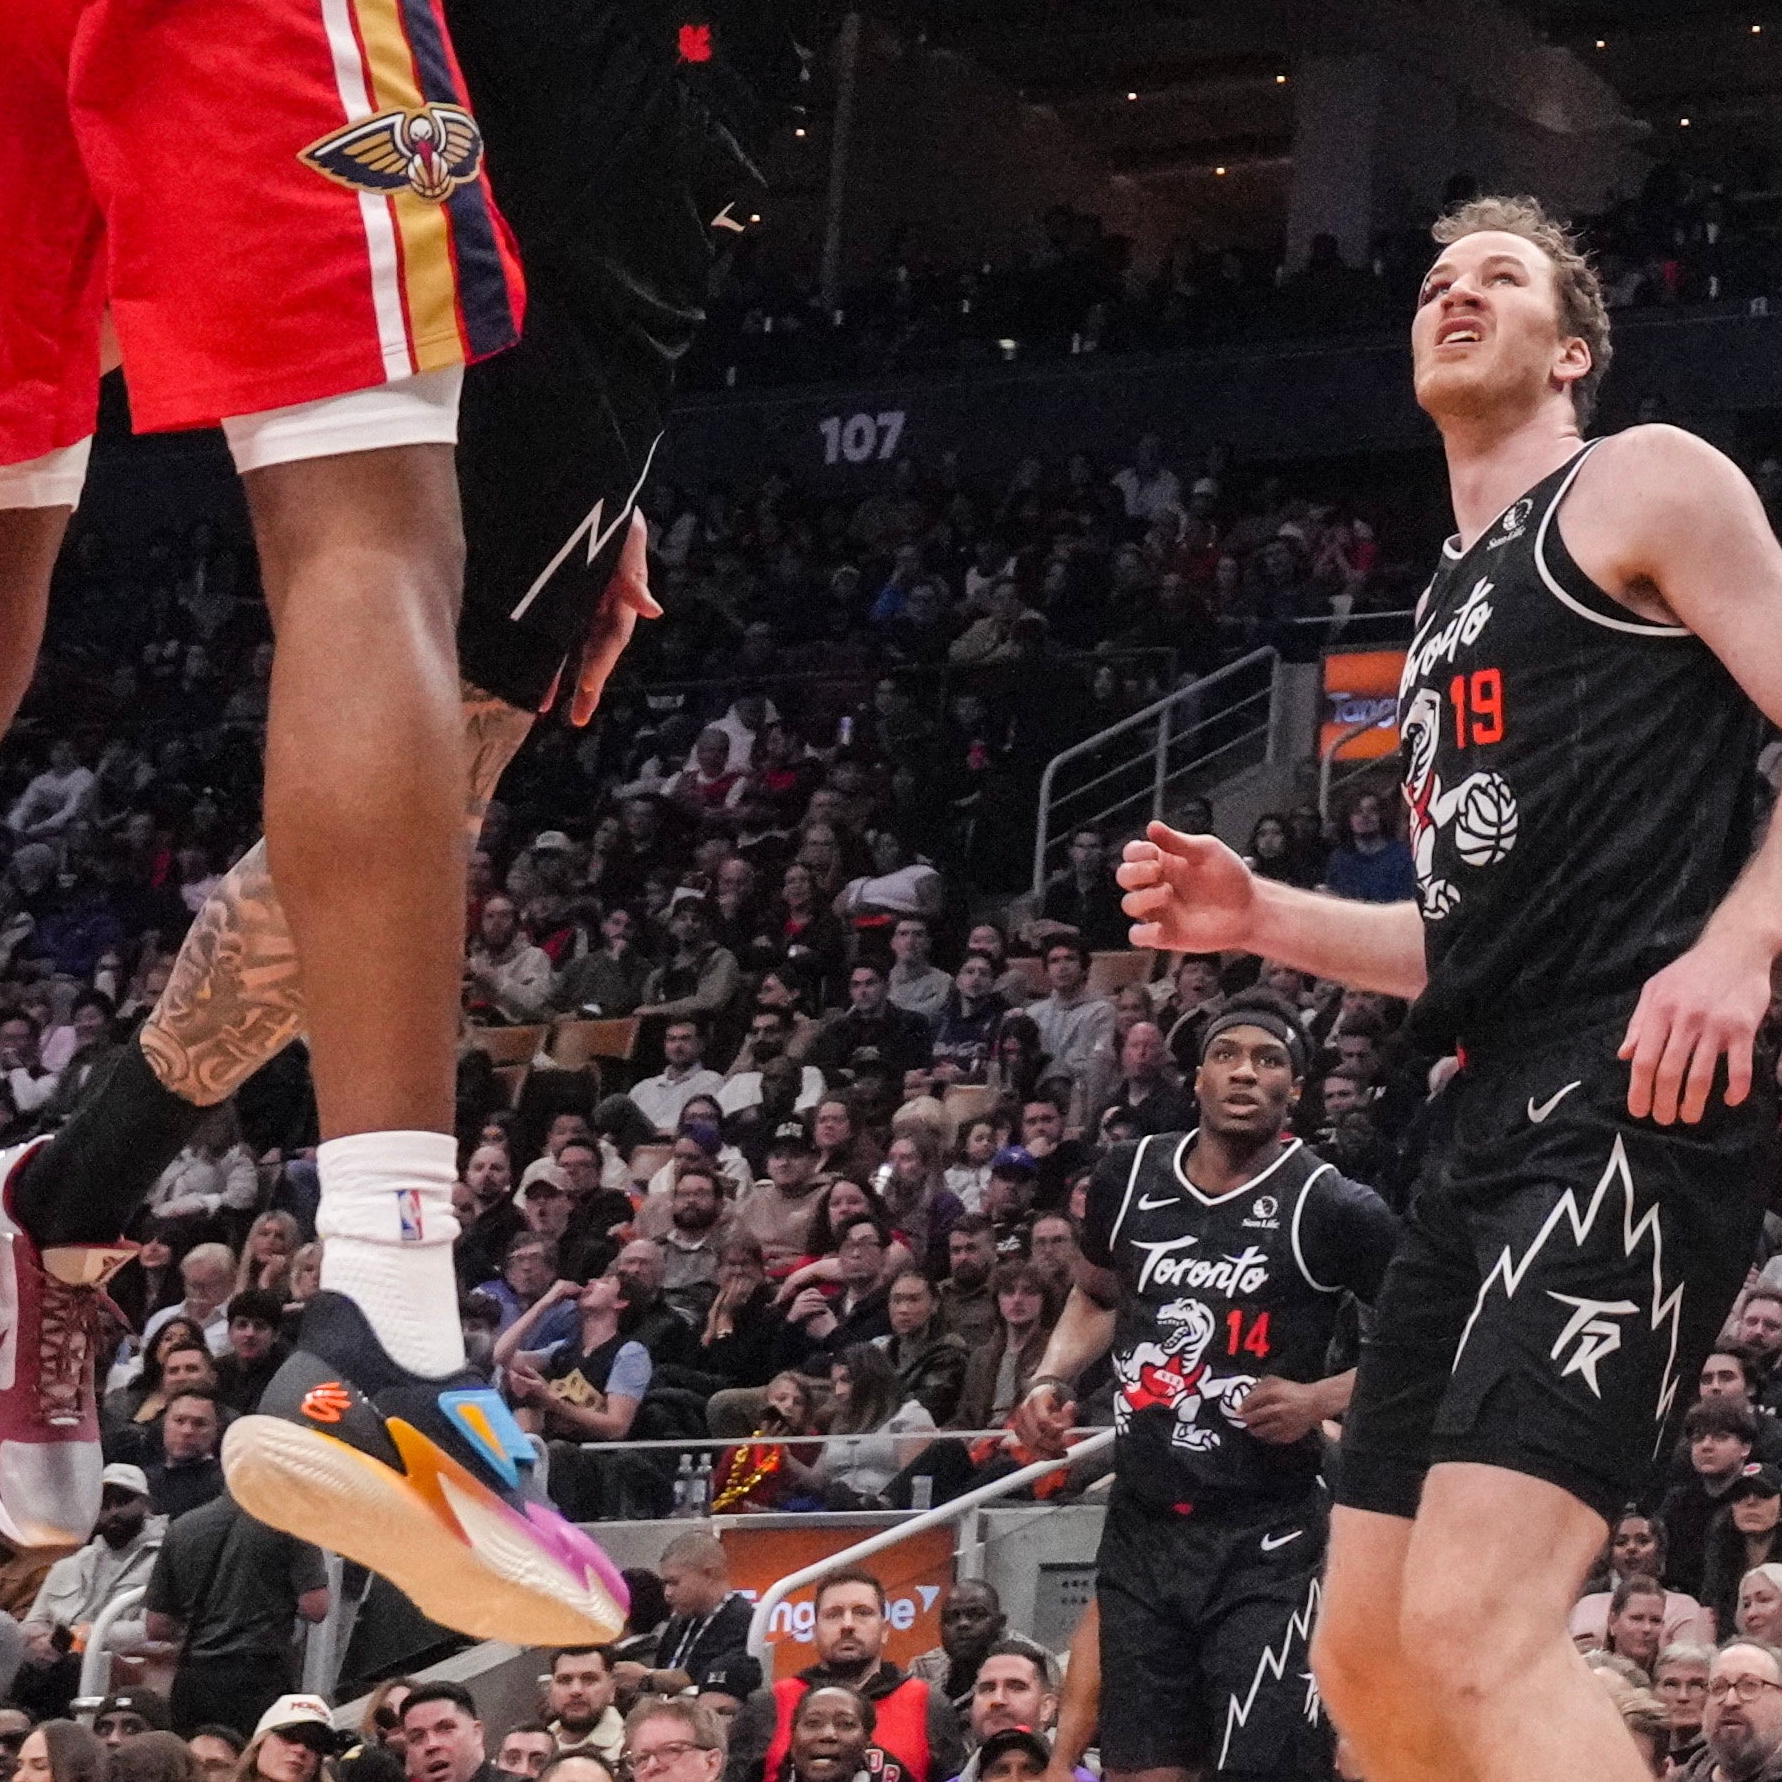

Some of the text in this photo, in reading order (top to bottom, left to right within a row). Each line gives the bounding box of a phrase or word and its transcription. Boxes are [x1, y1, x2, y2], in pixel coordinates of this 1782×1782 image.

[819, 409, 906, 465] 107
[1449, 667, 1504, 750] 19
[1129, 1234, 1270, 1299] Toronto
[1226, 1309, 1271, 1359] 14
